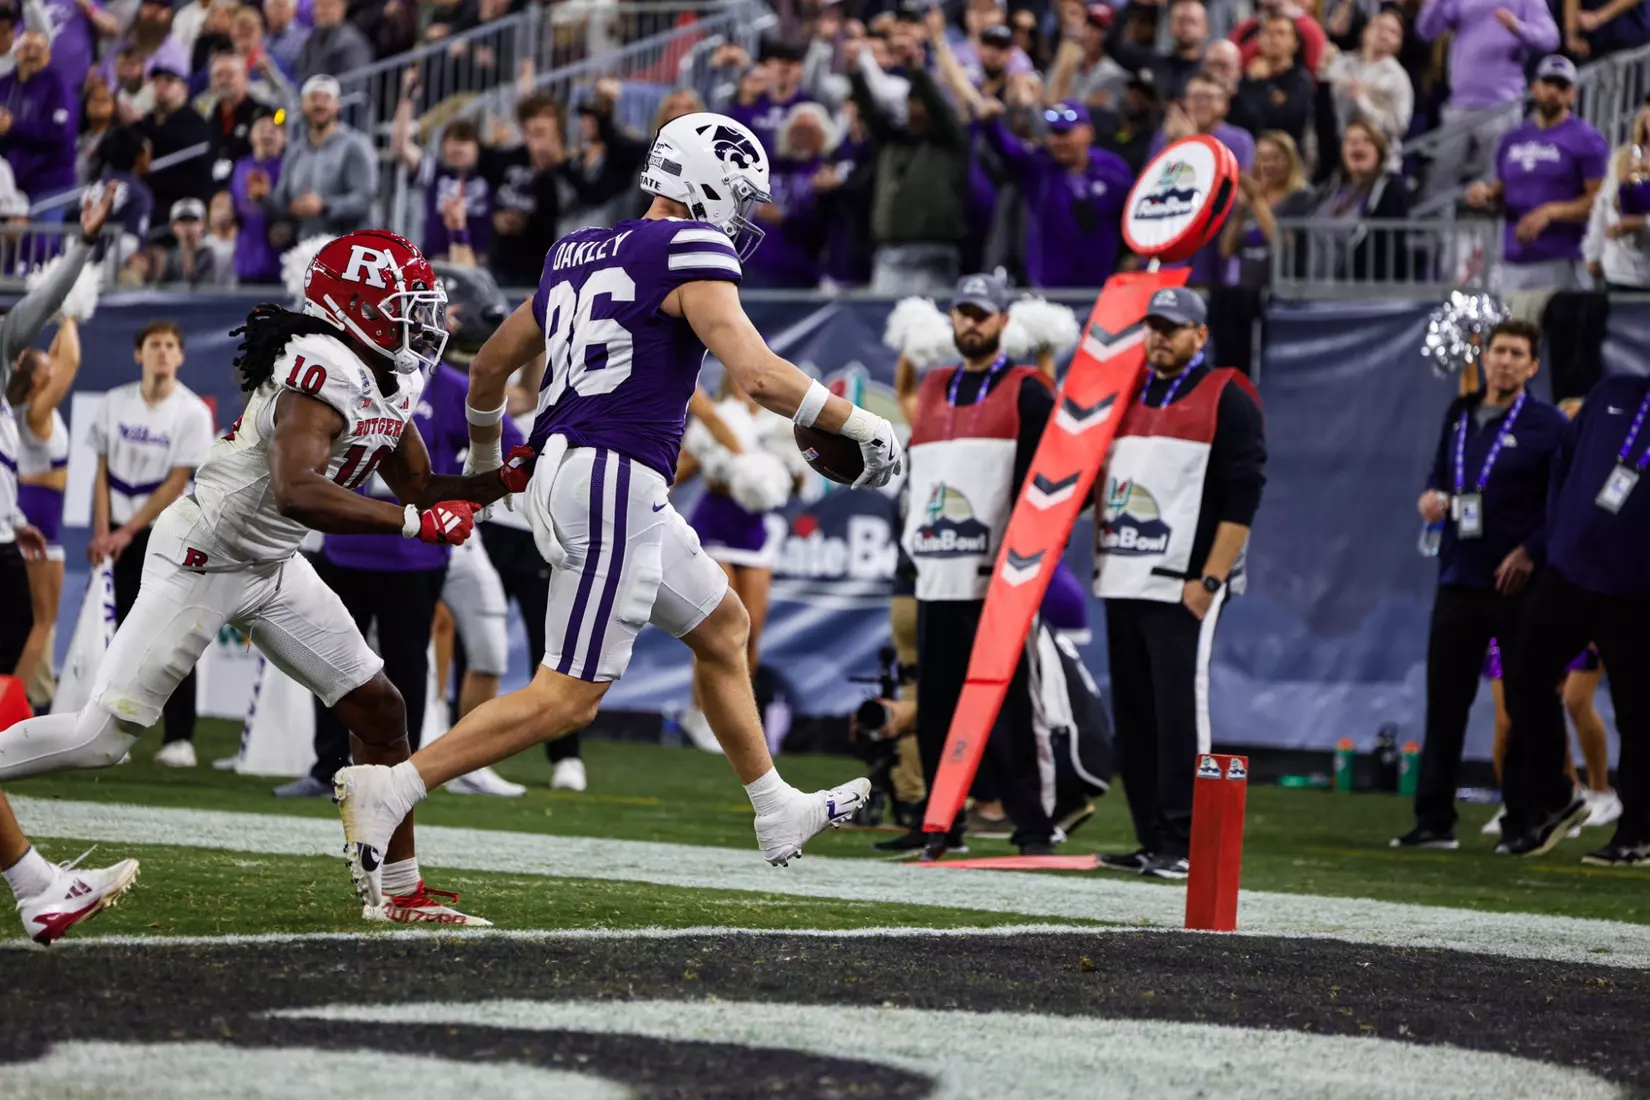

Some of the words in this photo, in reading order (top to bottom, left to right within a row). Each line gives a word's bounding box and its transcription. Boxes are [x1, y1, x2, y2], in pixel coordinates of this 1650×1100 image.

[341, 245, 389, 289] R
[553, 230, 633, 271] OAKLEY
[536, 266, 636, 418] 86
[285, 355, 327, 395] 10
